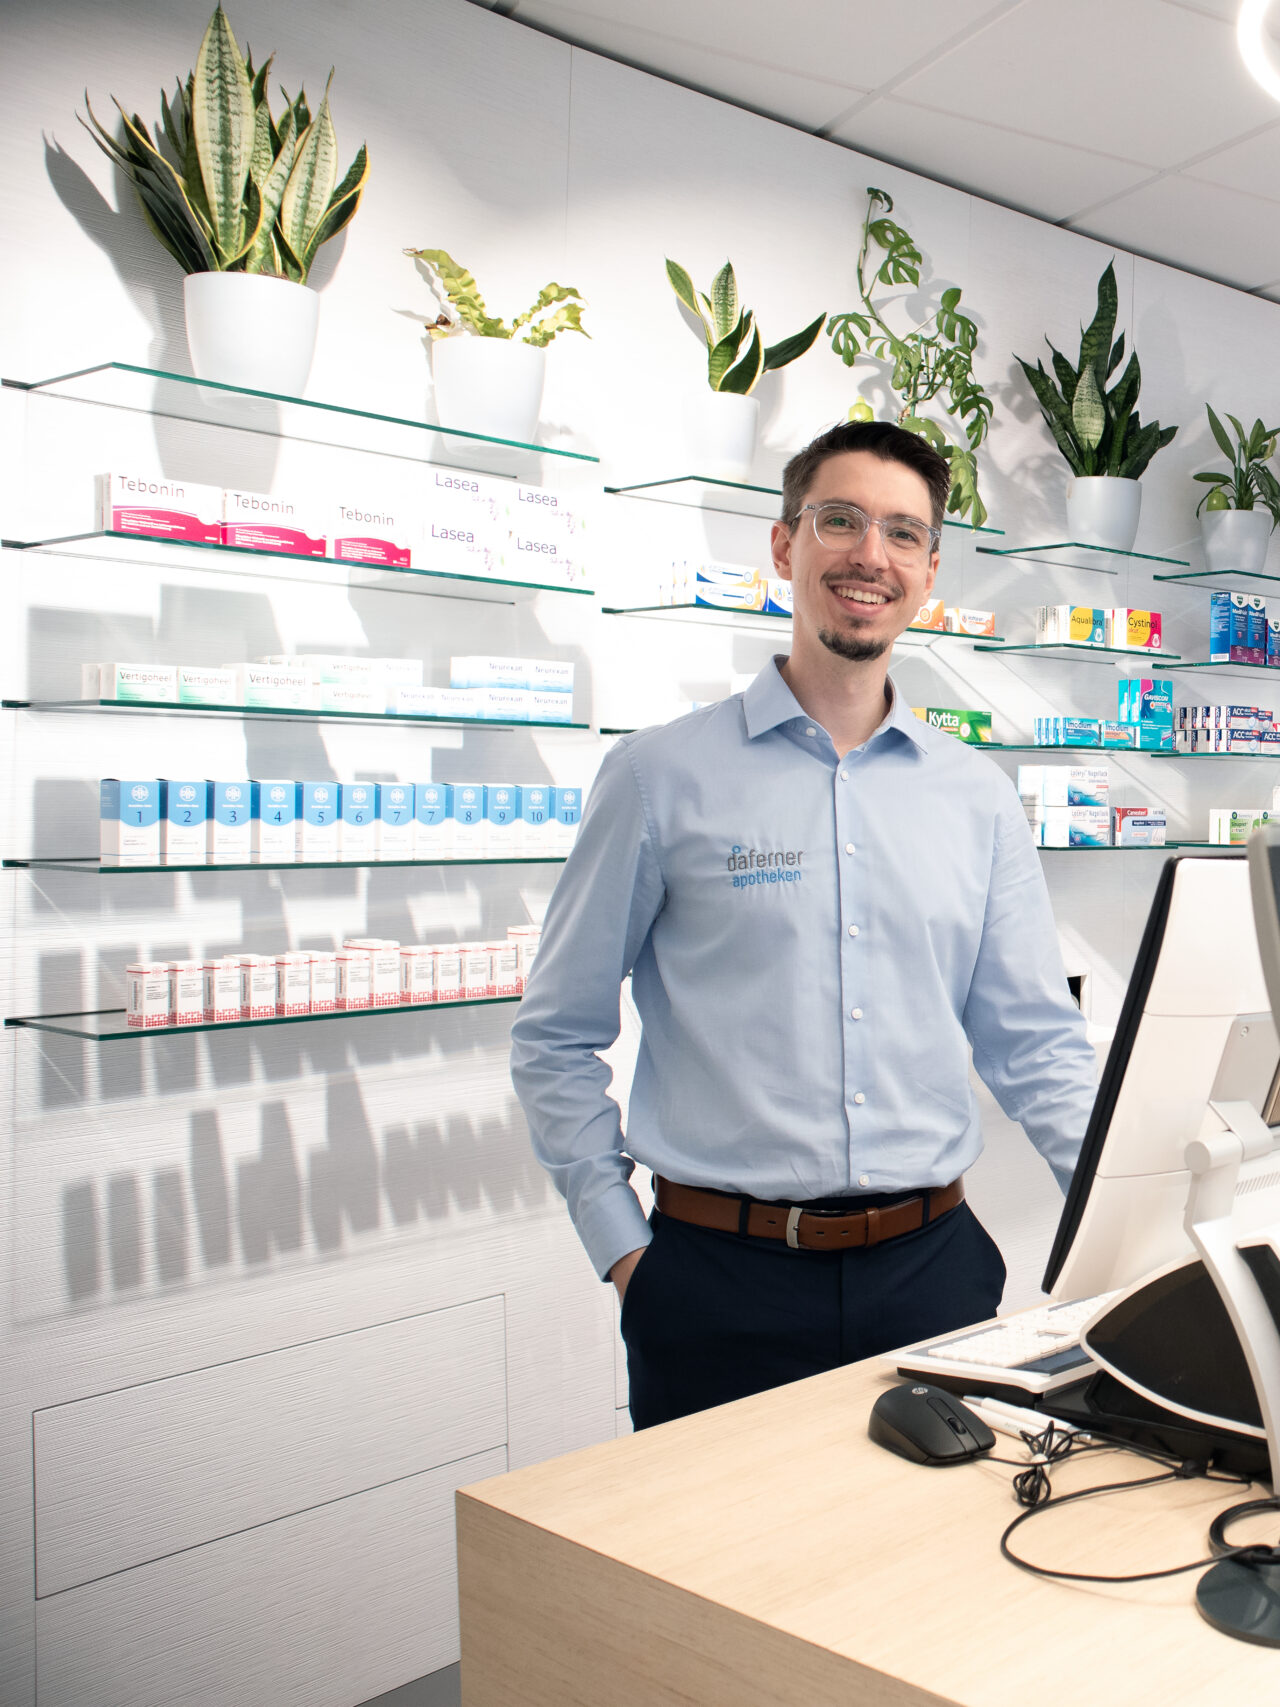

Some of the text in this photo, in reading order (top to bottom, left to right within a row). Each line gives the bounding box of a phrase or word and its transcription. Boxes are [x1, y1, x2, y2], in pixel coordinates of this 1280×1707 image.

[119, 475, 186, 499] Tebonin
[435, 472, 480, 493] Lasea
[518, 488, 558, 507] Lasea
[234, 494, 296, 515] Tebonin
[339, 506, 396, 527] Tebonin
[431, 524, 476, 544] Lasea
[517, 537, 557, 556] Lasea
[1072, 615, 1104, 627] Aqualibra
[1128, 617, 1158, 629] Cystinol
[120, 671, 173, 684] Vertigoheel
[183, 674, 233, 687] Vertigoheel
[248, 673, 307, 688] Vertigoheel
[929, 711, 960, 729] Kytta
[1067, 720, 1093, 730] Imodium
[1106, 723, 1129, 733] Imodium
[136, 811, 144, 824] 1
[183, 811, 193, 824] 2
[229, 811, 238, 823] 3
[273, 811, 283, 823] 4
[317, 811, 325, 824] 5
[355, 811, 364, 824] 6
[393, 811, 402, 824] 7
[427, 811, 436, 824] 7
[464, 811, 473, 823] 8
[498, 812, 507, 824] 9
[531, 811, 544, 823] 10
[564, 811, 576, 823] 11
[727, 848, 804, 872] daferner
[733, 868, 802, 890] apotheken
